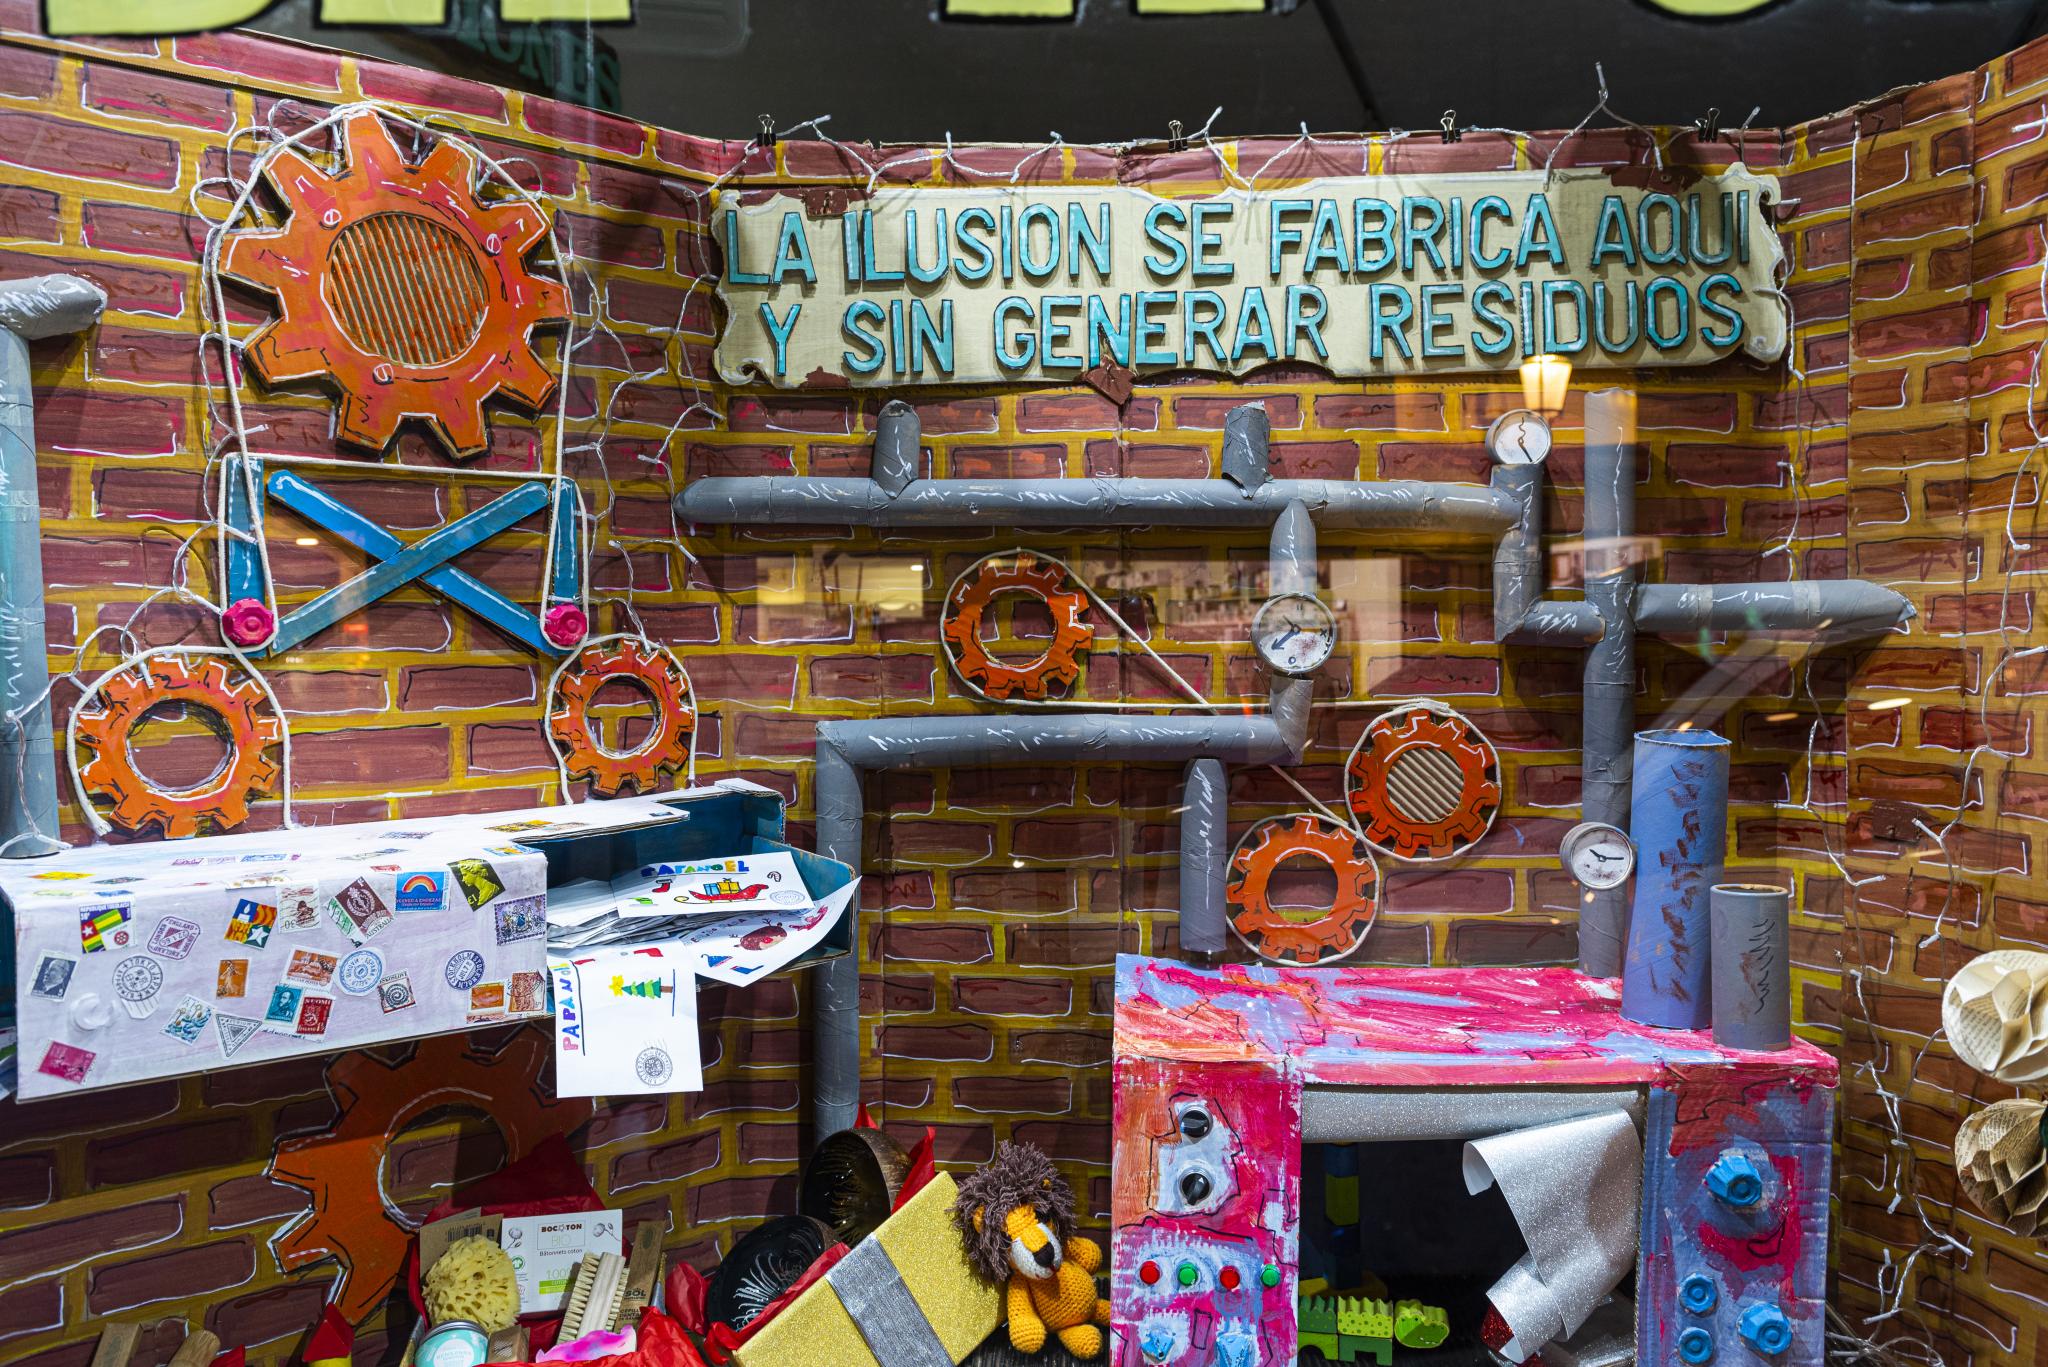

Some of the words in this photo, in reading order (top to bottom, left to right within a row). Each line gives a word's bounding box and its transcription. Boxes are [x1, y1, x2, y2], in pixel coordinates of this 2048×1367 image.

[725, 209, 819, 285] LA
[843, 201, 1112, 283] ILUSION
[1143, 201, 1236, 277] SE
[1269, 192, 1565, 275] FABRICA
[1591, 189, 1752, 268] AQUI
[759, 301, 803, 376] Y
[842, 298, 955, 374] SIN
[993, 284, 1329, 371] GENERAR
[1368, 271, 1744, 360] RESIDUOS
[304, 998, 331, 1006] SUOMI
